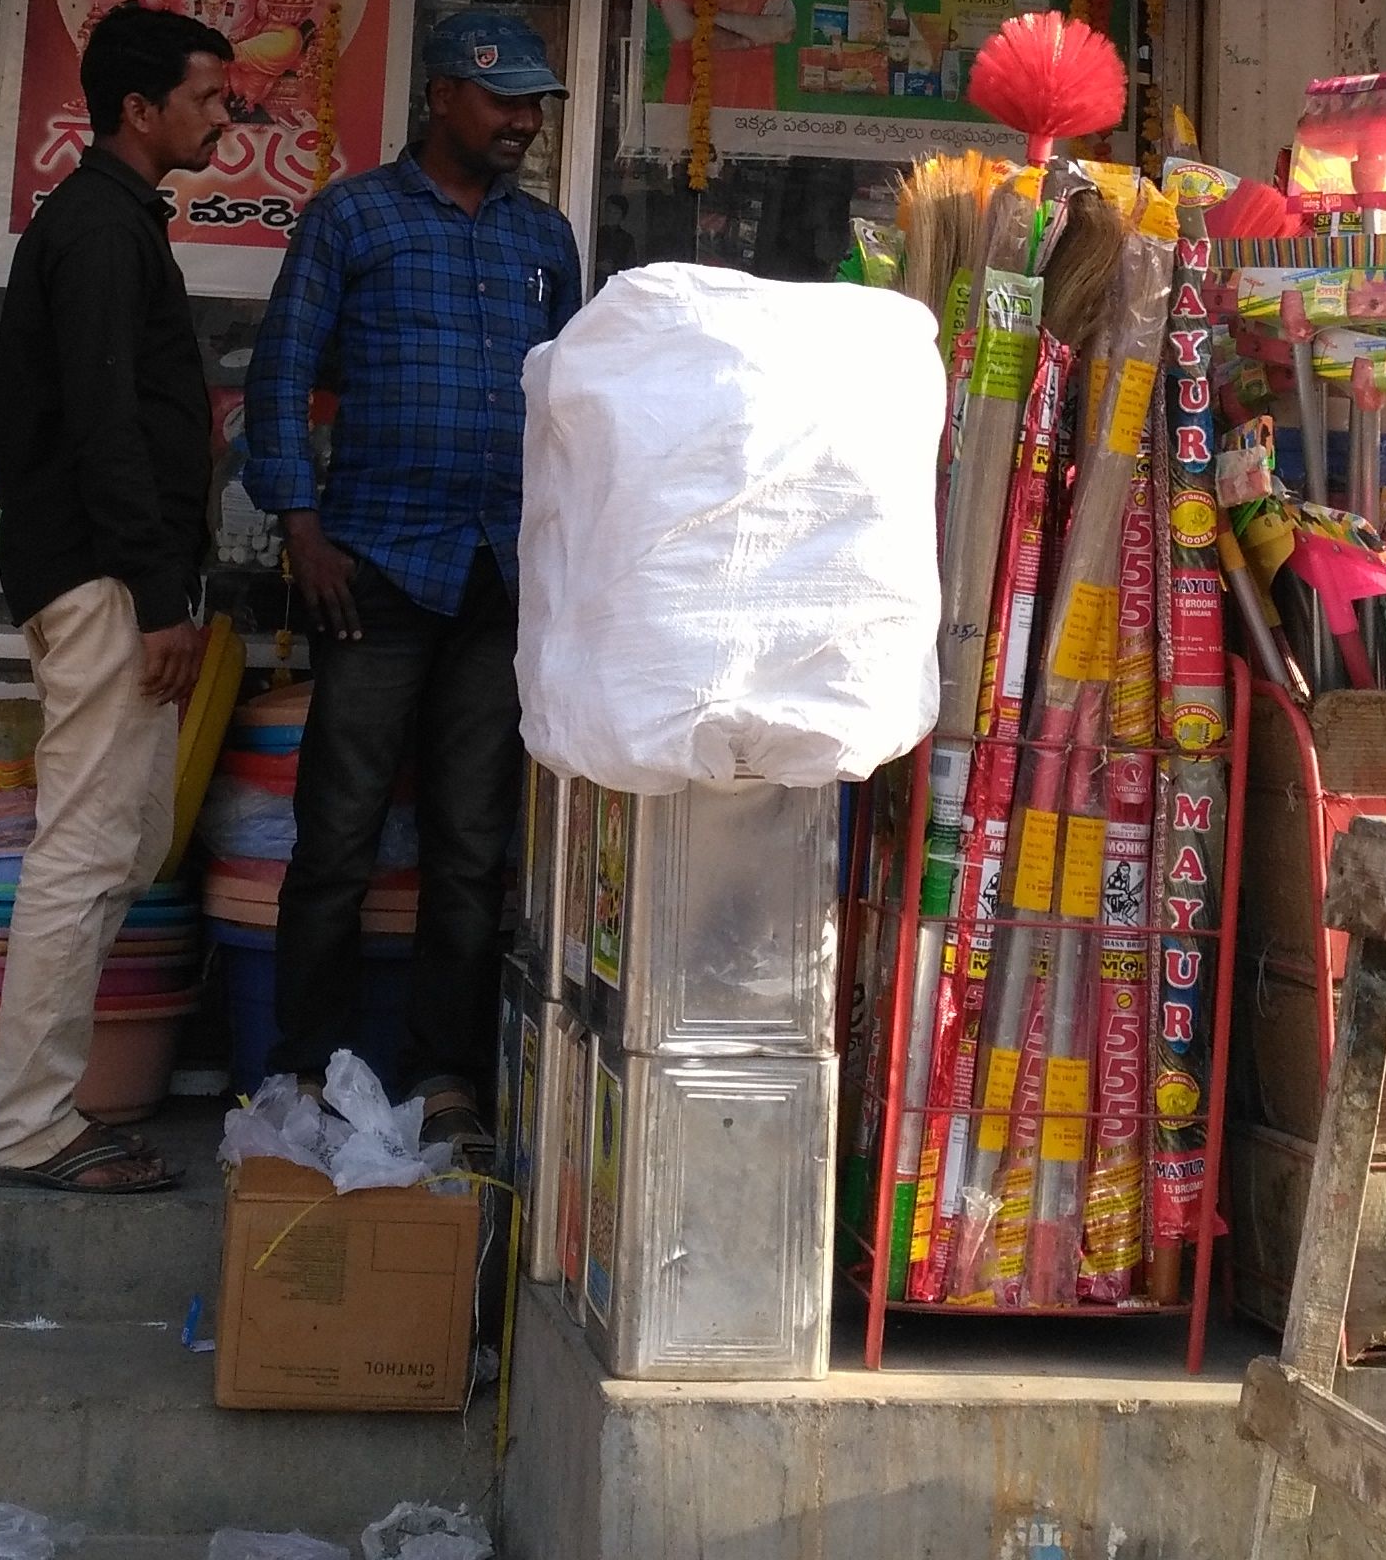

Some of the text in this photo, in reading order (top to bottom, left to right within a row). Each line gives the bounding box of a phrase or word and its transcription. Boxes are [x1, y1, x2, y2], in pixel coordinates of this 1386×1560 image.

[734, 116, 778, 137] ఇక్కడ
[784, 117, 847, 135] పతంజలి
[1171, 236, 1213, 467] MAYUR
[1175, 530, 1214, 545] BROOMS
[1185, 598, 1218, 609] BROOMS
[364, 1359, 436, 1378] CINTHOL
